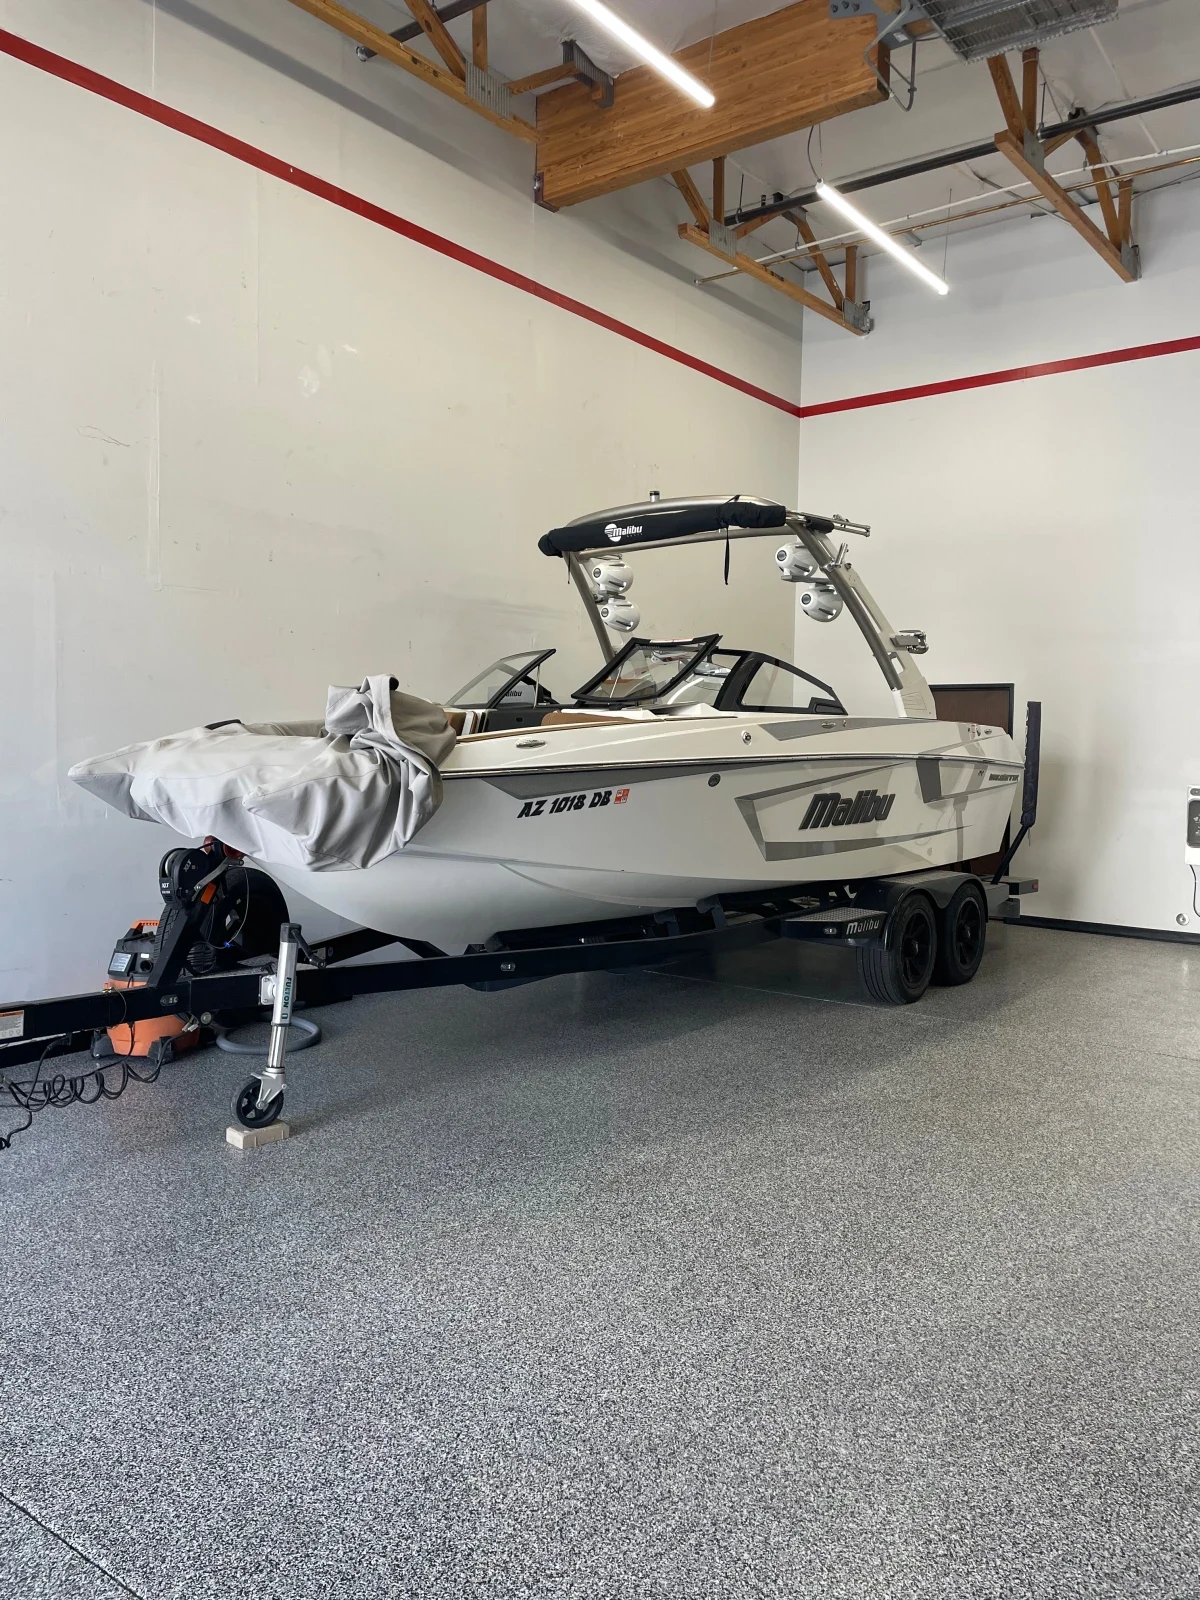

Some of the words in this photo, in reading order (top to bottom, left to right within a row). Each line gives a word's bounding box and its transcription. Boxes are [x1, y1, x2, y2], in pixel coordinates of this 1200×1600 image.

[612, 525, 643, 537] Malibu
[516, 799, 548, 819] AZ
[548, 794, 587, 814] 1018
[588, 790, 612, 808] DB
[798, 789, 896, 830] Malibu
[846, 919, 880, 935] Malibu
[283, 977, 292, 1008] FULTON
